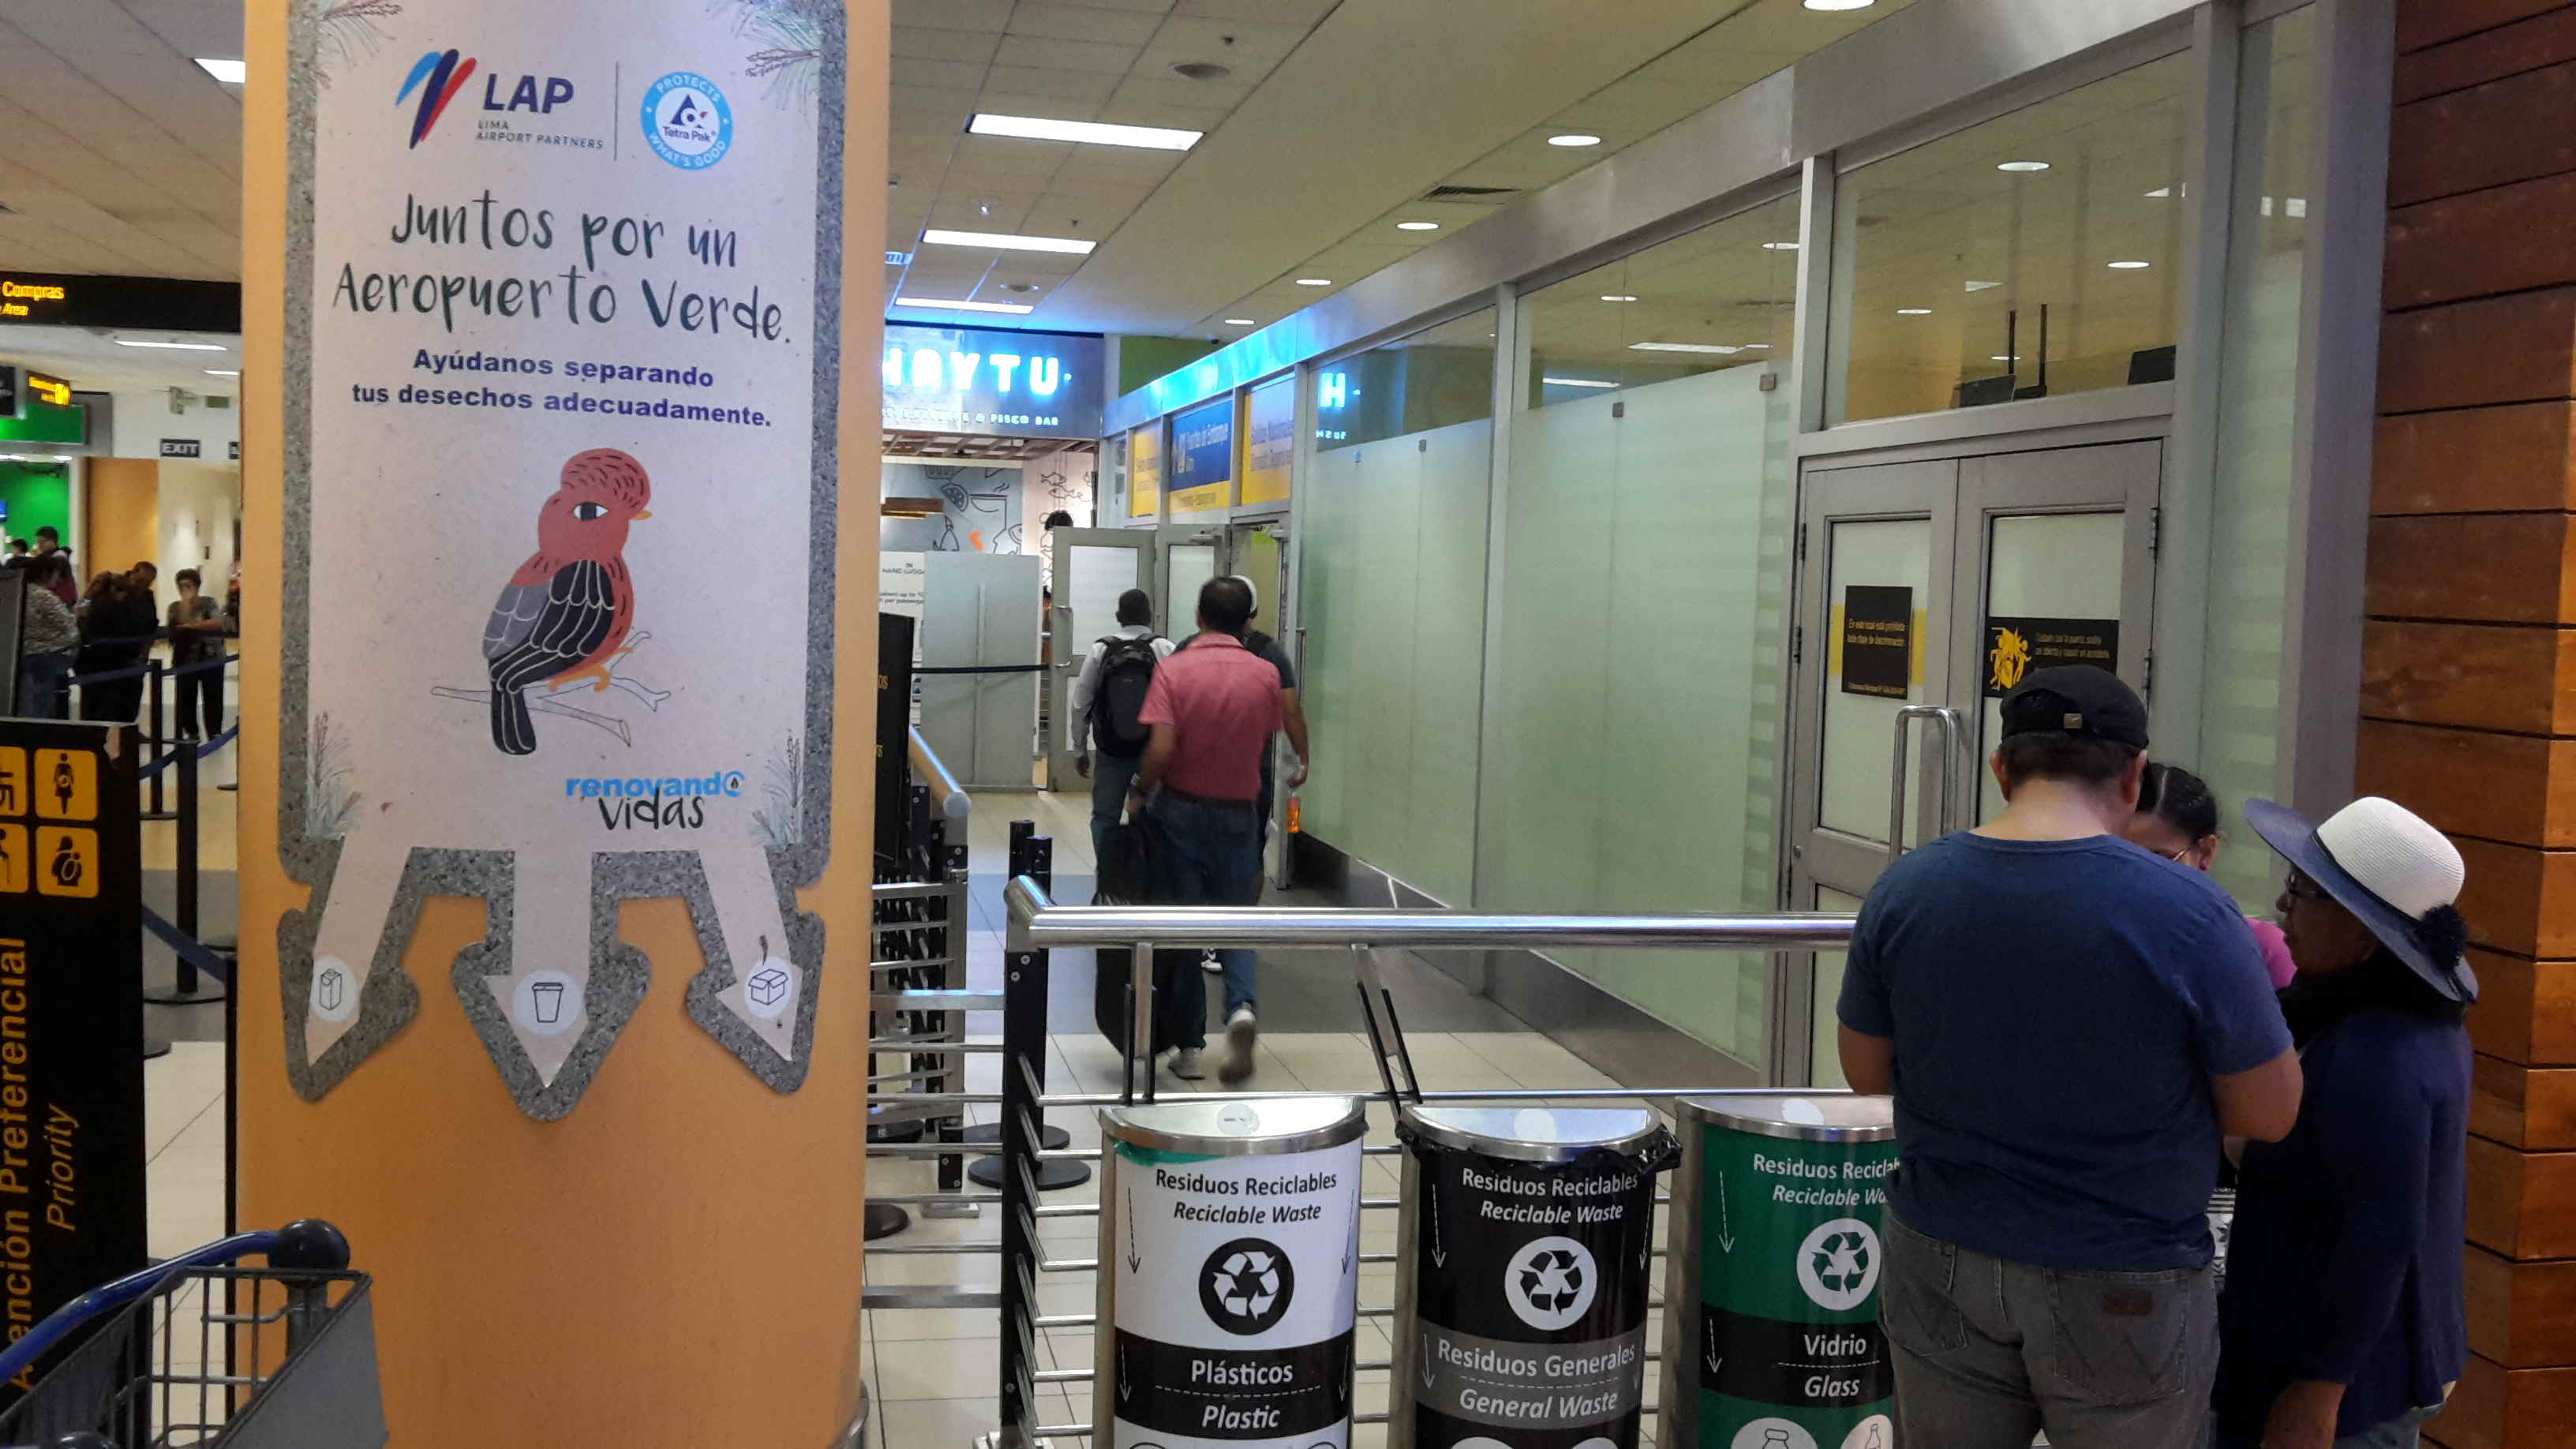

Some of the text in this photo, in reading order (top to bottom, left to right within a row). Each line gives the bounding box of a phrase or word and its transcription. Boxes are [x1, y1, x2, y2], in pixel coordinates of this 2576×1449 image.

[483, 73, 574, 114] LAP
[656, 74, 721, 102] PROTECTS
[477, 120, 509, 130] LIMA
[662, 125, 690, 140] Tetra
[476, 131, 604, 149] AIRPORT PARTNERS
[694, 140, 727, 167] GOOD
[391, 189, 736, 271] Juntos por un
[2, 281, 65, 301] Compras
[332, 262, 792, 343] Aeropuerto Verde.
[413, 349, 713, 388] Ayúdanos separando
[352, 384, 772, 427] tus desechos adecuadamente.
[163, 442, 198, 455] EXIT
[0, 938, 34, 1391] Aención Preferencial
[45, 1103, 80, 1232] Priority
[1754, 1153, 1900, 1180] Residuos Reciclab
[1156, 1169, 1338, 1196] Residuos Reciclables
[1462, 1168, 1638, 1196] Residuos Reciclables
[1773, 1185, 1860, 1206] Reciclable
[1174, 1202, 1322, 1224] Reciclable Waste
[1481, 1200, 1623, 1224] Reciclable Waste
[1438, 1340, 1636, 1377] Residuos Generales
[1804, 1334, 1866, 1357] Vidrio
[1191, 1360, 1294, 1386] Plásticos
[1804, 1375, 1860, 1398] Glass
[1460, 1388, 1619, 1419] General Waste
[1201, 1406, 1281, 1429] Plastic
